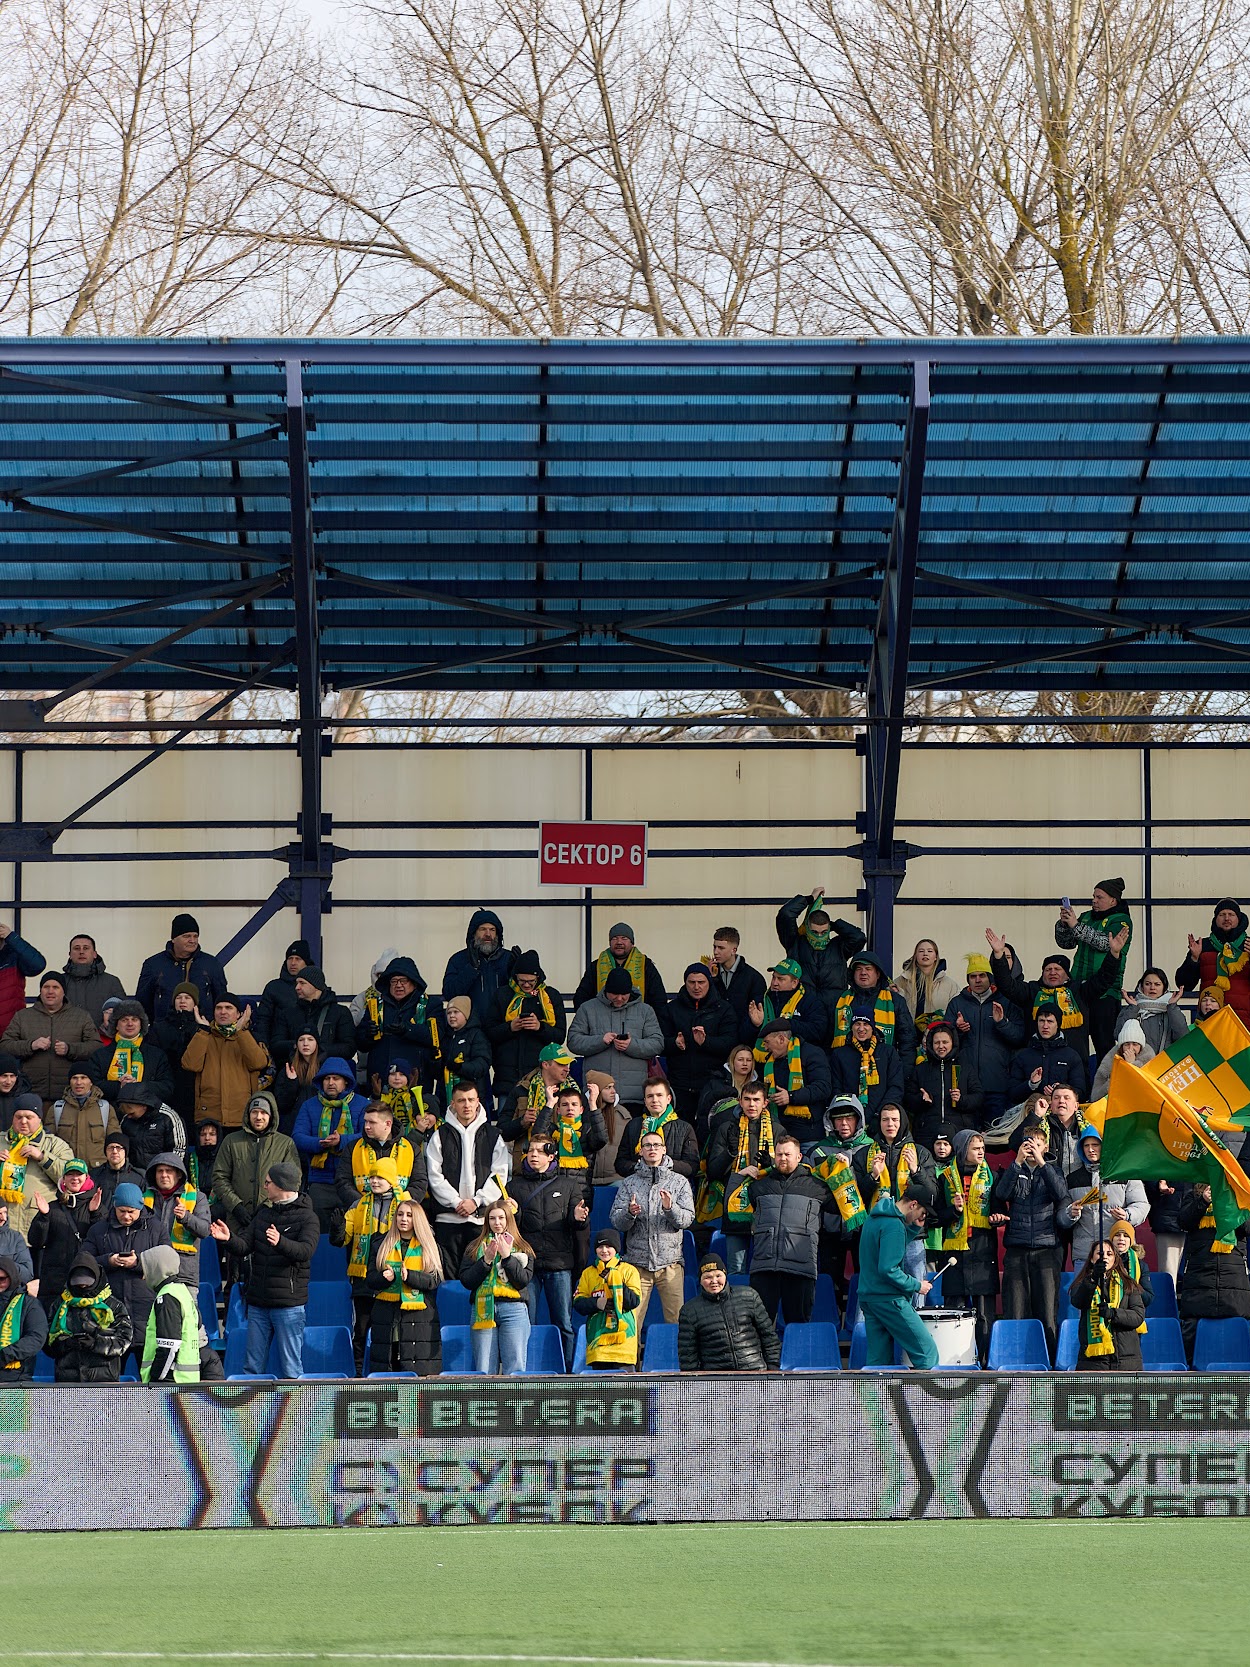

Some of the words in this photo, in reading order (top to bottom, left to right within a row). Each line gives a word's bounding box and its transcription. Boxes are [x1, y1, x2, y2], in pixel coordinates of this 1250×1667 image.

[544, 843, 625, 865] СЕКТОР
[630, 845, 642, 866] 6
[432, 1399, 643, 1427] BET.ERA
[417, 1460, 656, 1492] СУПЕР
